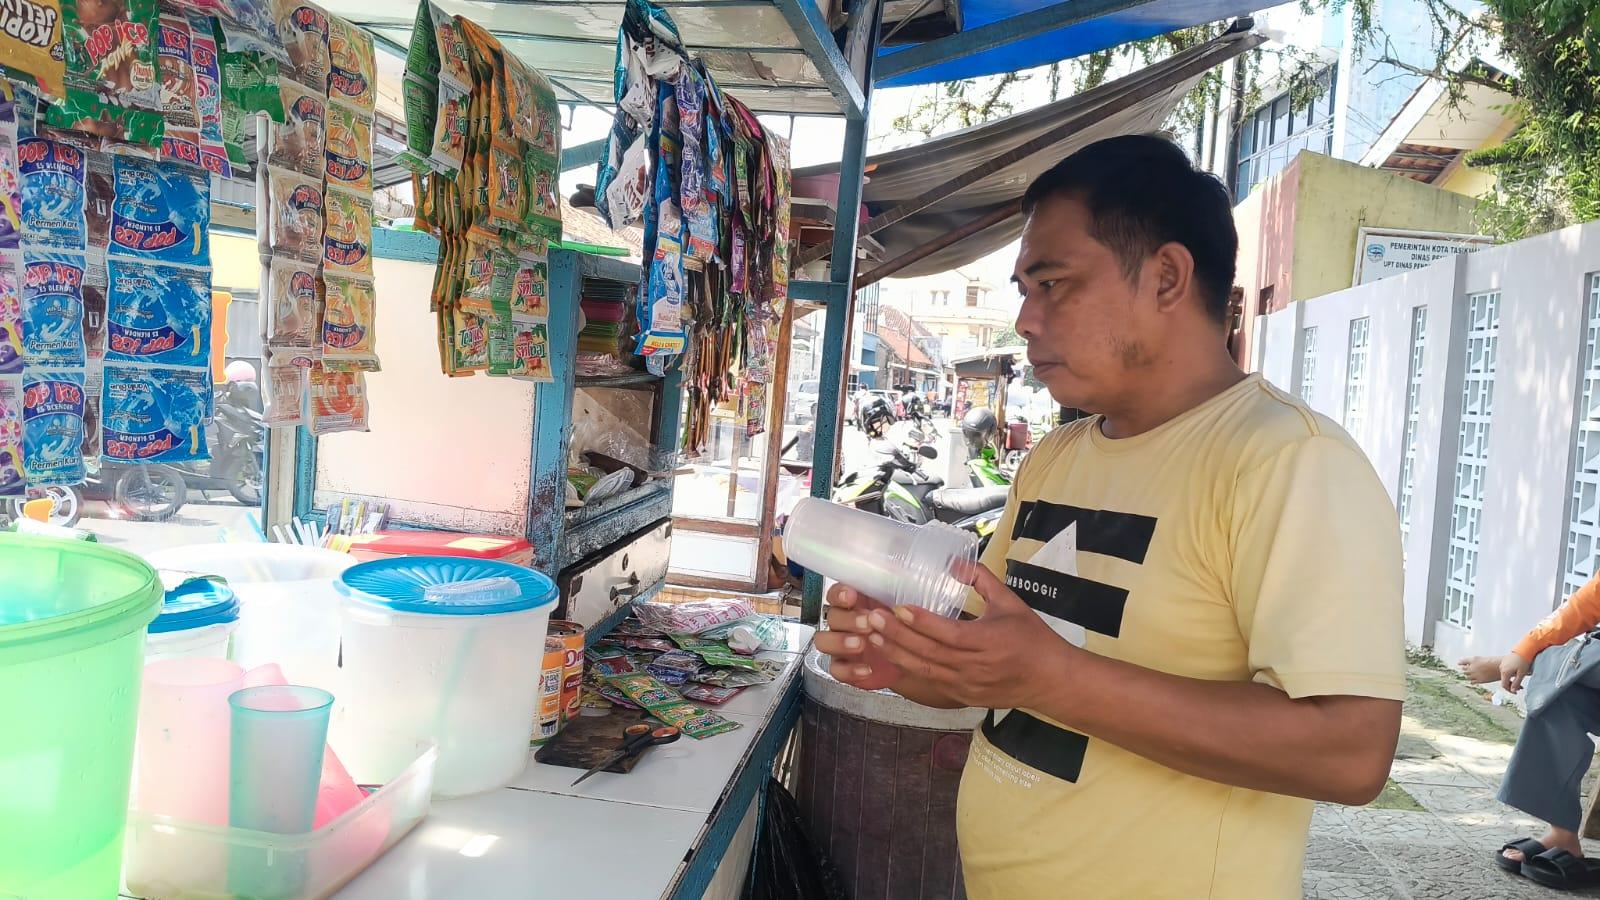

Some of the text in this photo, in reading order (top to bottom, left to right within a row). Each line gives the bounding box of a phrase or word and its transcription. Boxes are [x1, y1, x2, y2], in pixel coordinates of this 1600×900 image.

[0, 8, 53, 47] KOPI
[84, 24, 113, 66] POP
[17, 141, 49, 168] POP
[29, 215, 62, 228] Permen
[143, 227, 176, 248] POP
[1390, 242, 1430, 253] PEMERINTAH
[1431, 245, 1449, 253] KOTA
[1395, 261, 1412, 269] DINAS
[1410, 253, 1430, 261] DINAS
[30, 340, 61, 350] Permen
[141, 331, 175, 354] POP
[138, 433, 172, 457] POP
[31, 459, 62, 470] Permen
